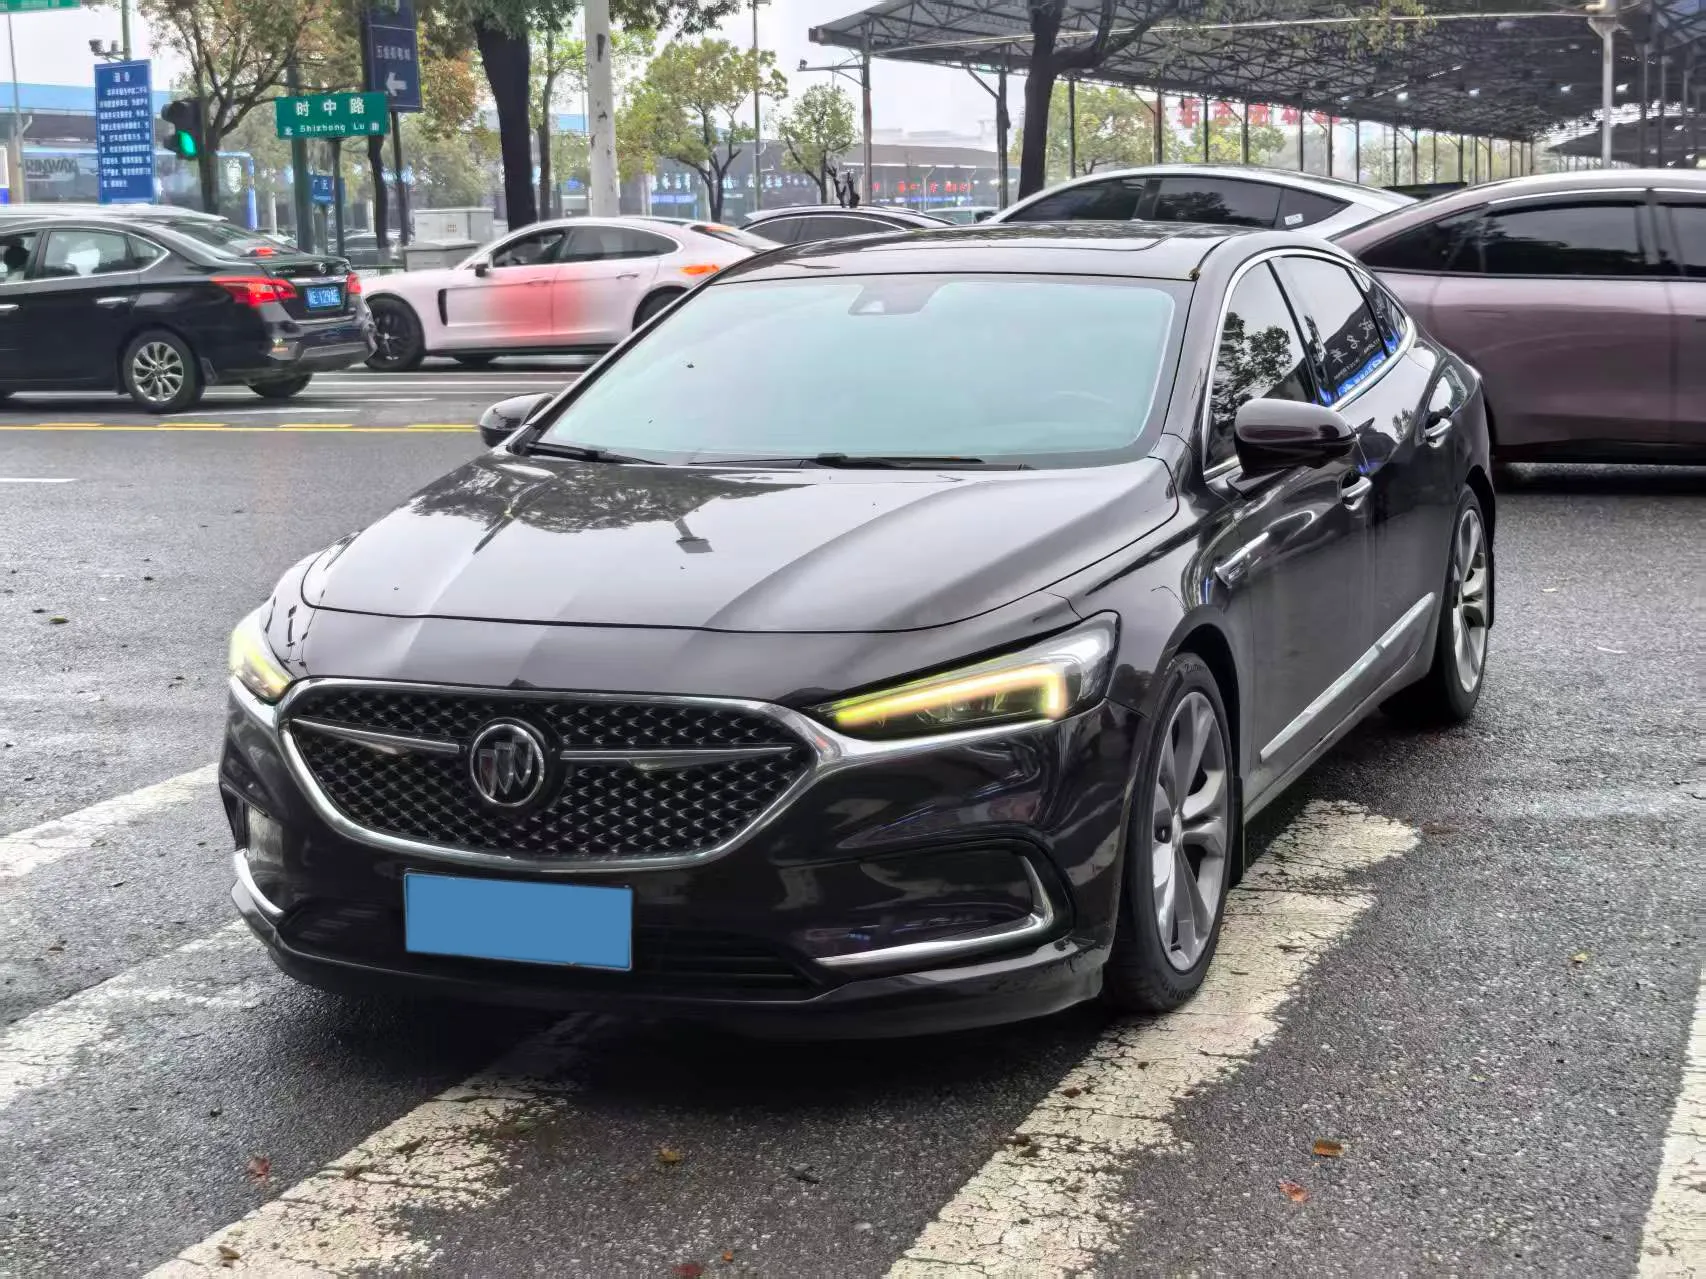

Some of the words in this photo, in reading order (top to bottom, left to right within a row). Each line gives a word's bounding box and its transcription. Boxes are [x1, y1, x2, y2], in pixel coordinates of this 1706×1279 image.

[296, 97, 365, 116] 时中路
[300, 123, 346, 132] Shizhong
[353, 122, 365, 130] Lu
